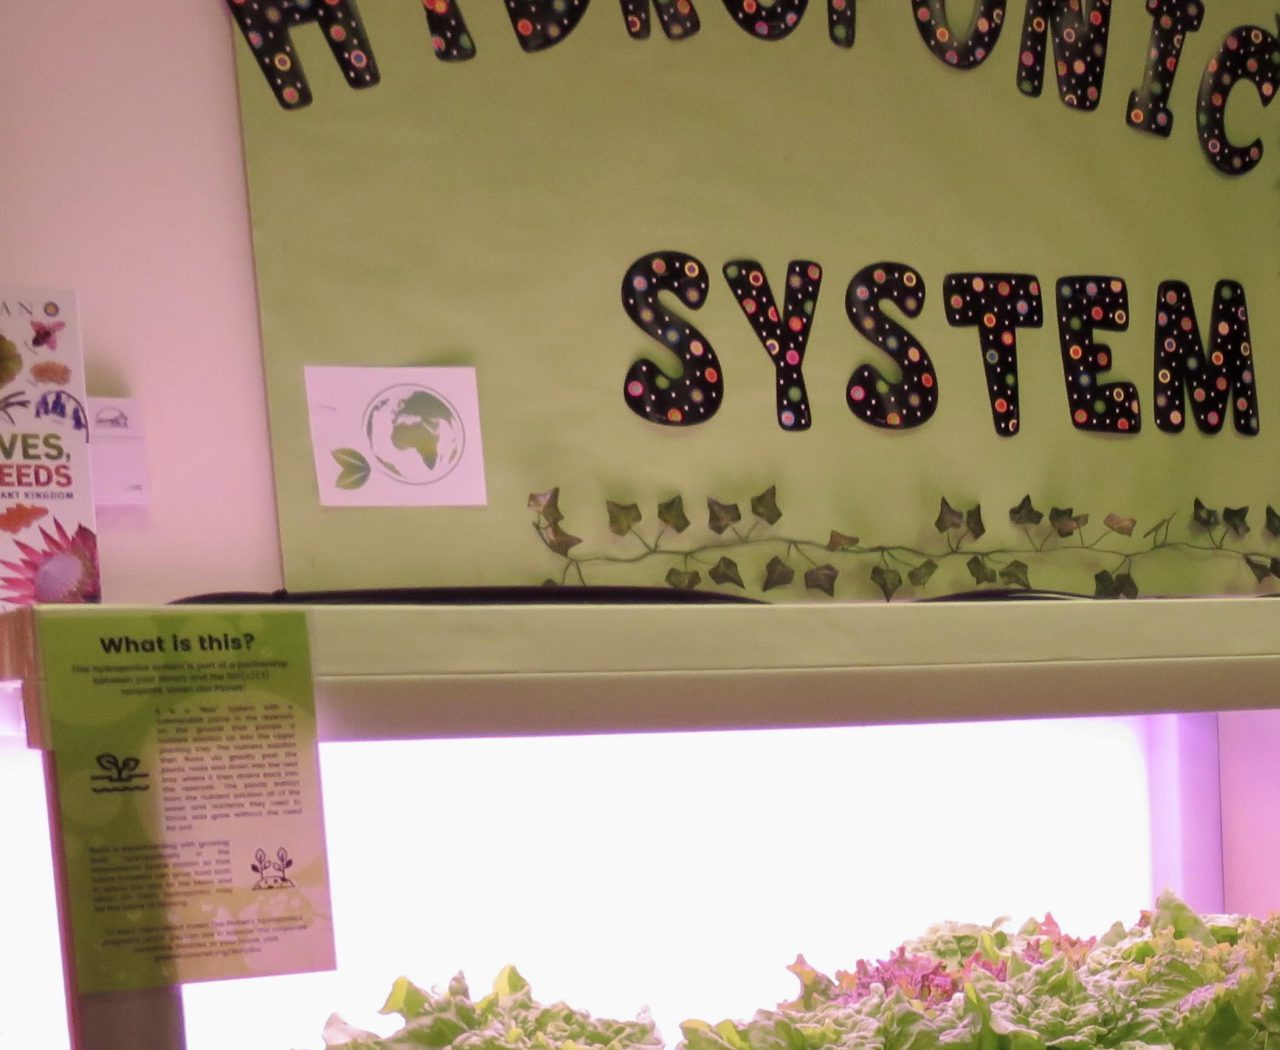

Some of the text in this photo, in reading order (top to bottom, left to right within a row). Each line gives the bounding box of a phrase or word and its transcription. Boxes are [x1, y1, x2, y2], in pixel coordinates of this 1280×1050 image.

[620, 250, 1260, 437] SYSTEM
[100, 633, 255, 654] What is this?
